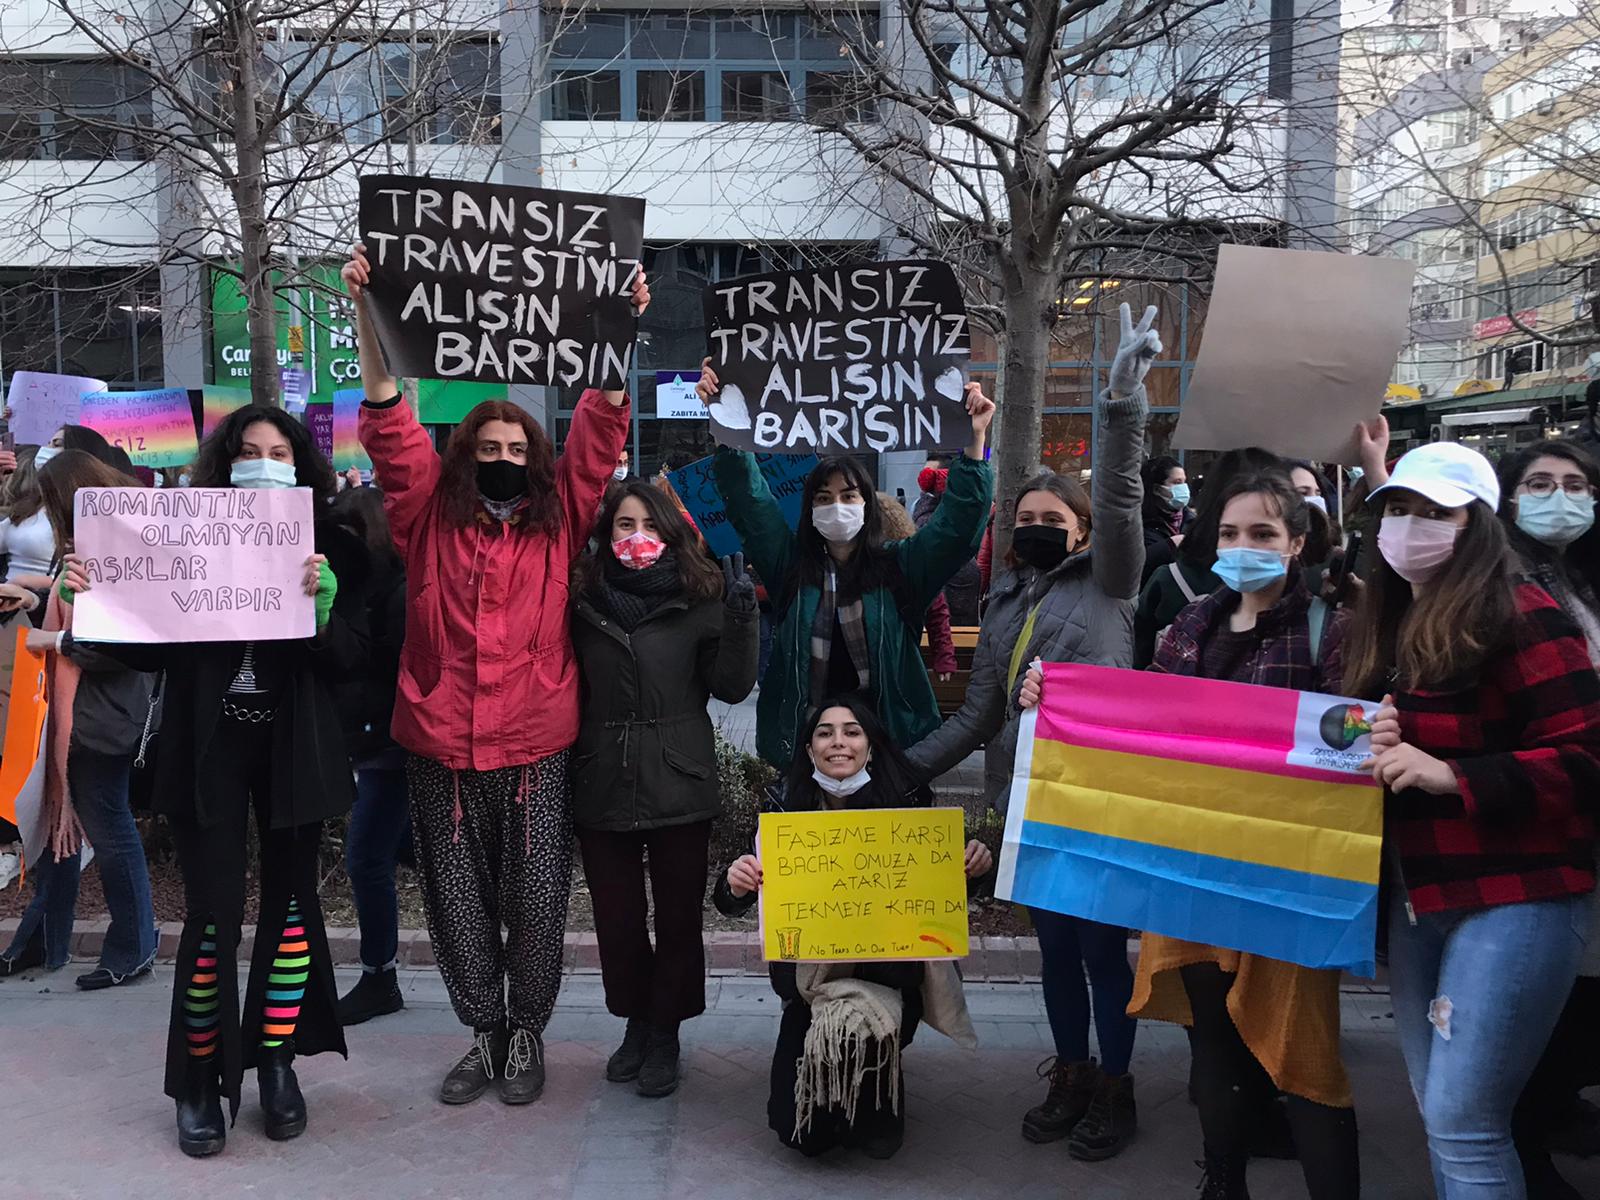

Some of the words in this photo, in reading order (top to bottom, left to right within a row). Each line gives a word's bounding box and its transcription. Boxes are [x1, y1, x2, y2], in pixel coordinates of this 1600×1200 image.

[401, 282, 560, 336] ALIŞIN
[435, 332, 632, 387] BARIŞIN
[760, 360, 925, 409] ALIŞIN
[754, 403, 941, 453] BARIŞIN
[141, 522, 300, 546] OLMAYAN
[84, 555, 207, 583] AŞKLAR
[171, 586, 282, 612] VARDIR
[891, 821, 951, 848] KARŞI
[777, 853, 844, 876] BACAK
[854, 852, 918, 871] OMUZA
[930, 850, 952, 864] DA
[832, 871, 908, 891] ATARIZ
[780, 901, 873, 921] TEKMEYE
[885, 899, 935, 916] KAFA
